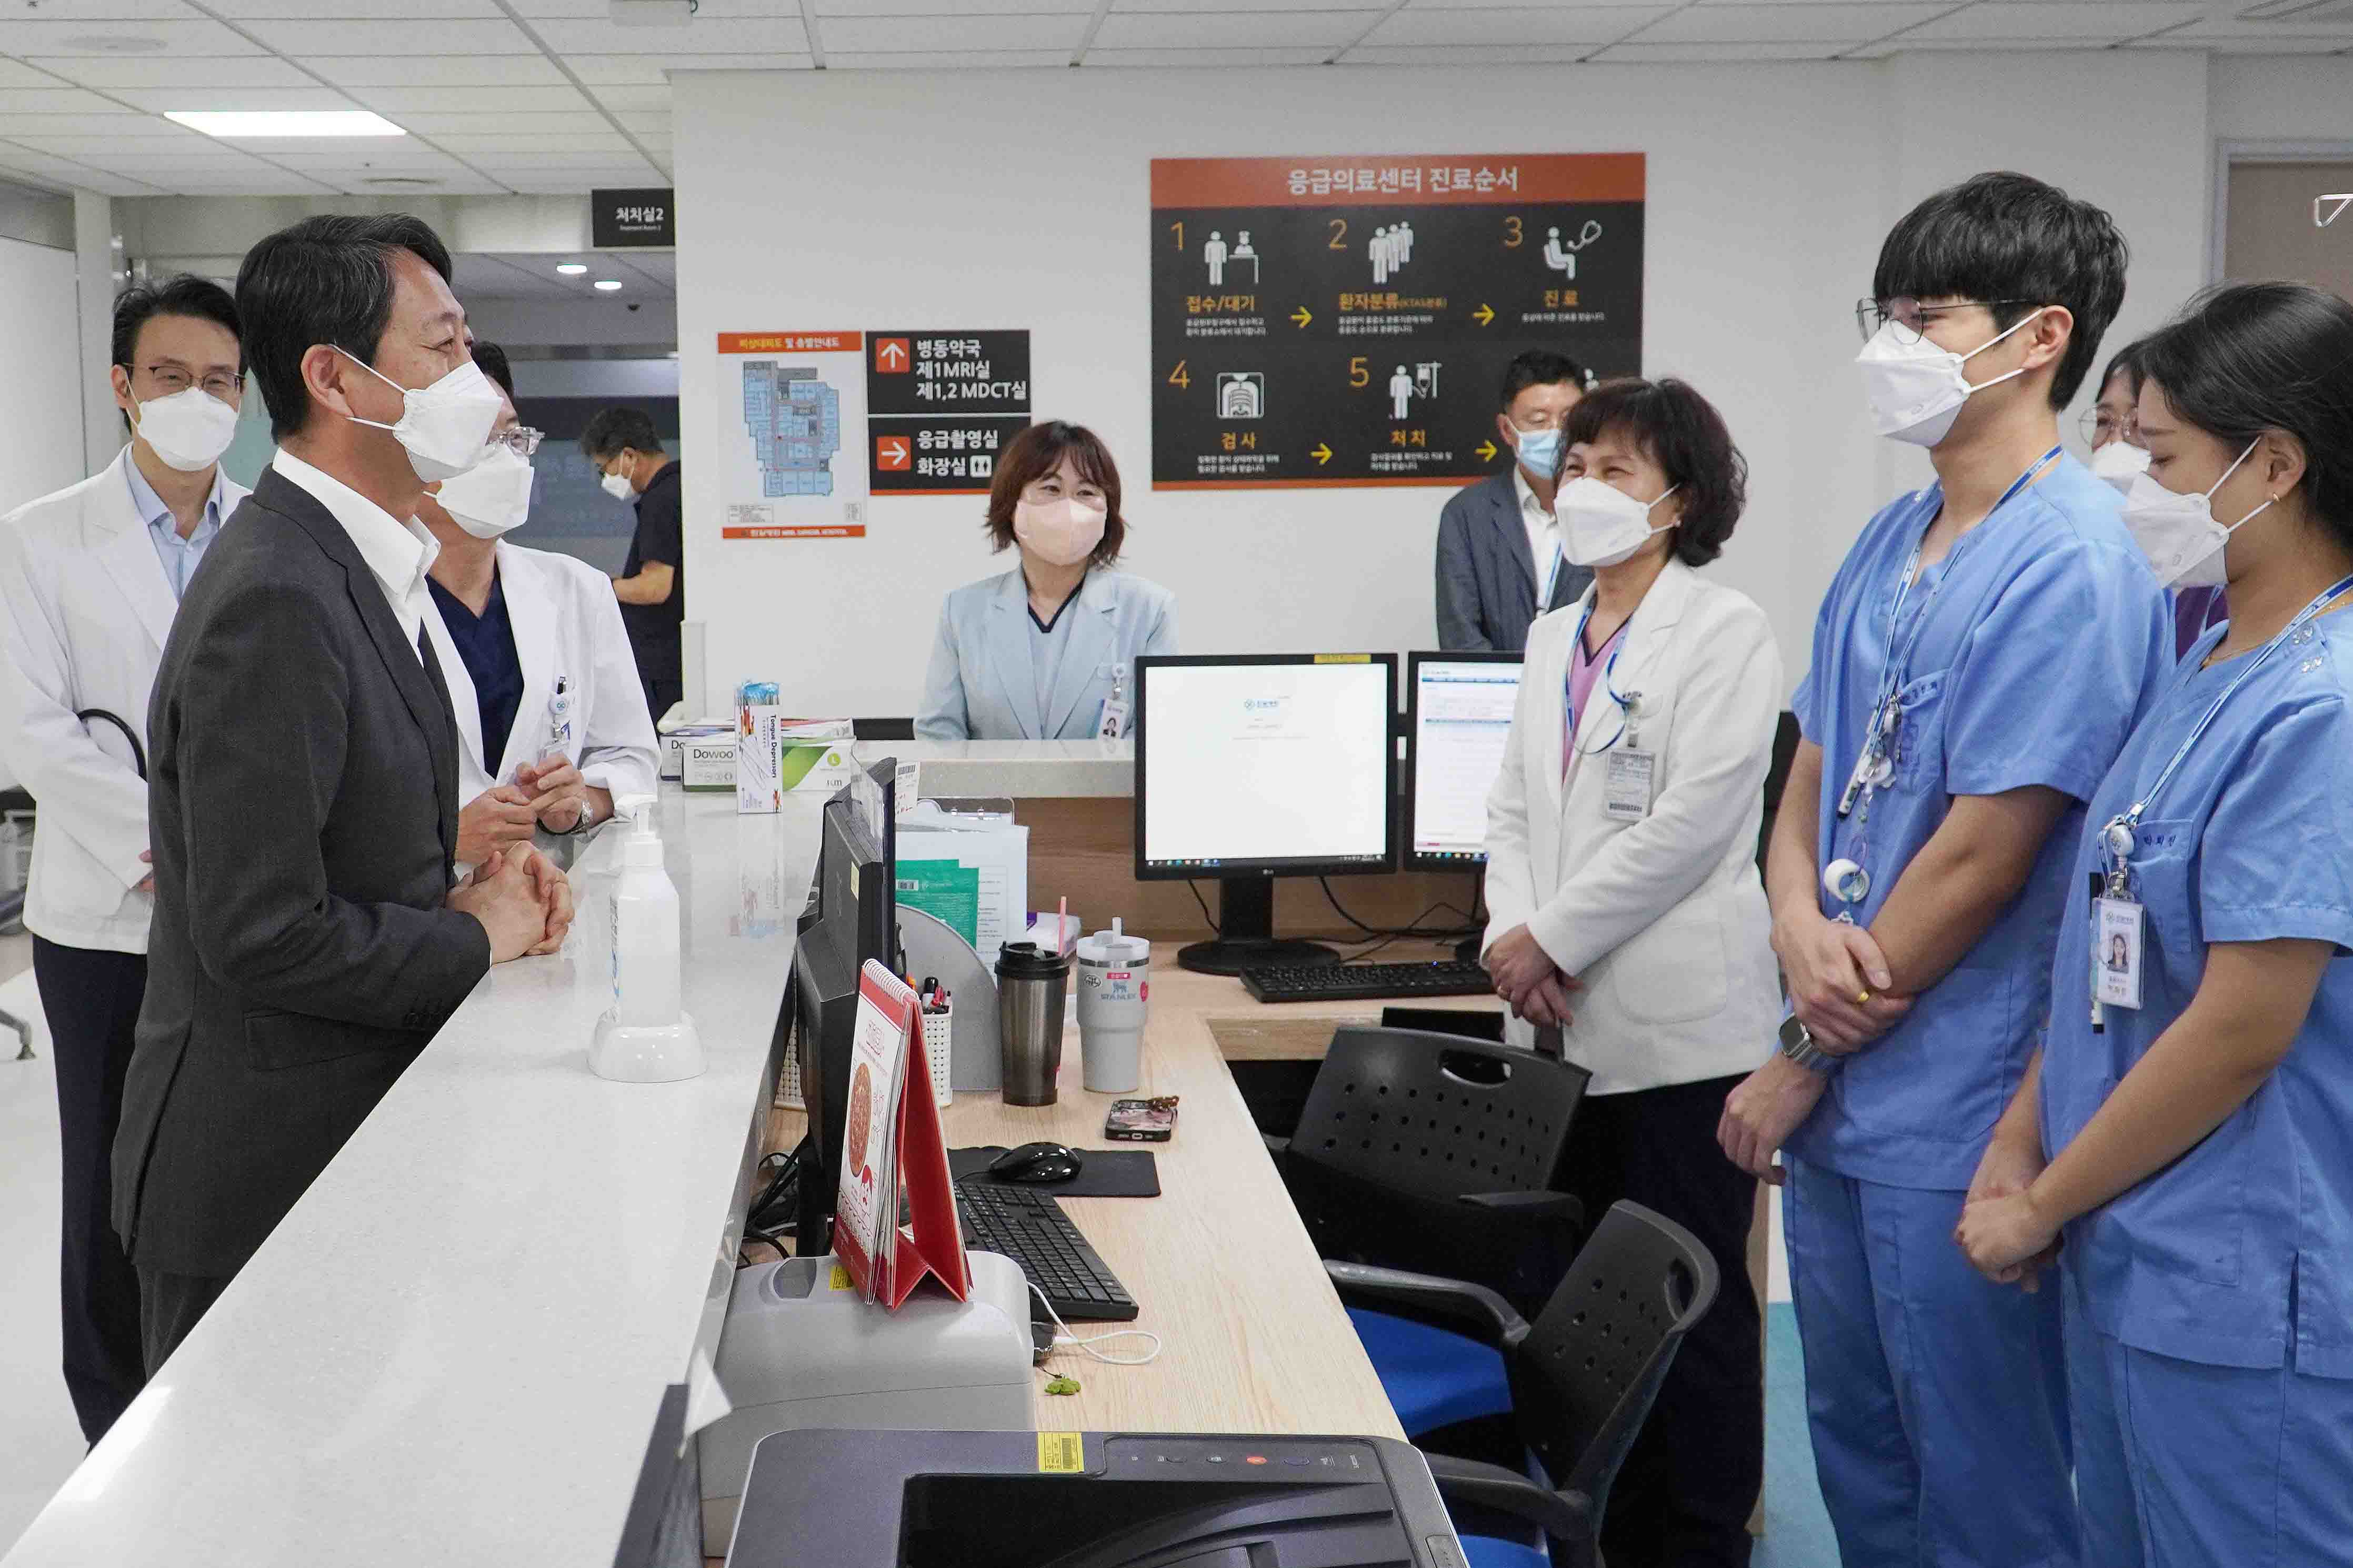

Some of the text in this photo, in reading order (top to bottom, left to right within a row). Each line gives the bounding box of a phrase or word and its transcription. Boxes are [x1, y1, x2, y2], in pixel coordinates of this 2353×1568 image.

[1287, 166, 1519, 194] 응급의료센터 진료순서
[615, 207, 664, 223] 처치실2
[1171, 222, 1184, 250] 1
[1329, 218, 1347, 249] 2
[1505, 216, 1524, 247] 3
[1187, 295, 1255, 313] 접수/대기
[917, 339, 981, 359] 병동약국
[1168, 359, 1190, 389] 4
[1350, 357, 1369, 388] 5
[916, 380, 1027, 402] 제1,2 MDCT실
[917, 430, 999, 450] 응급촬영실
[917, 456, 967, 477] 화장실
[694, 749, 734, 759] Dowoo
